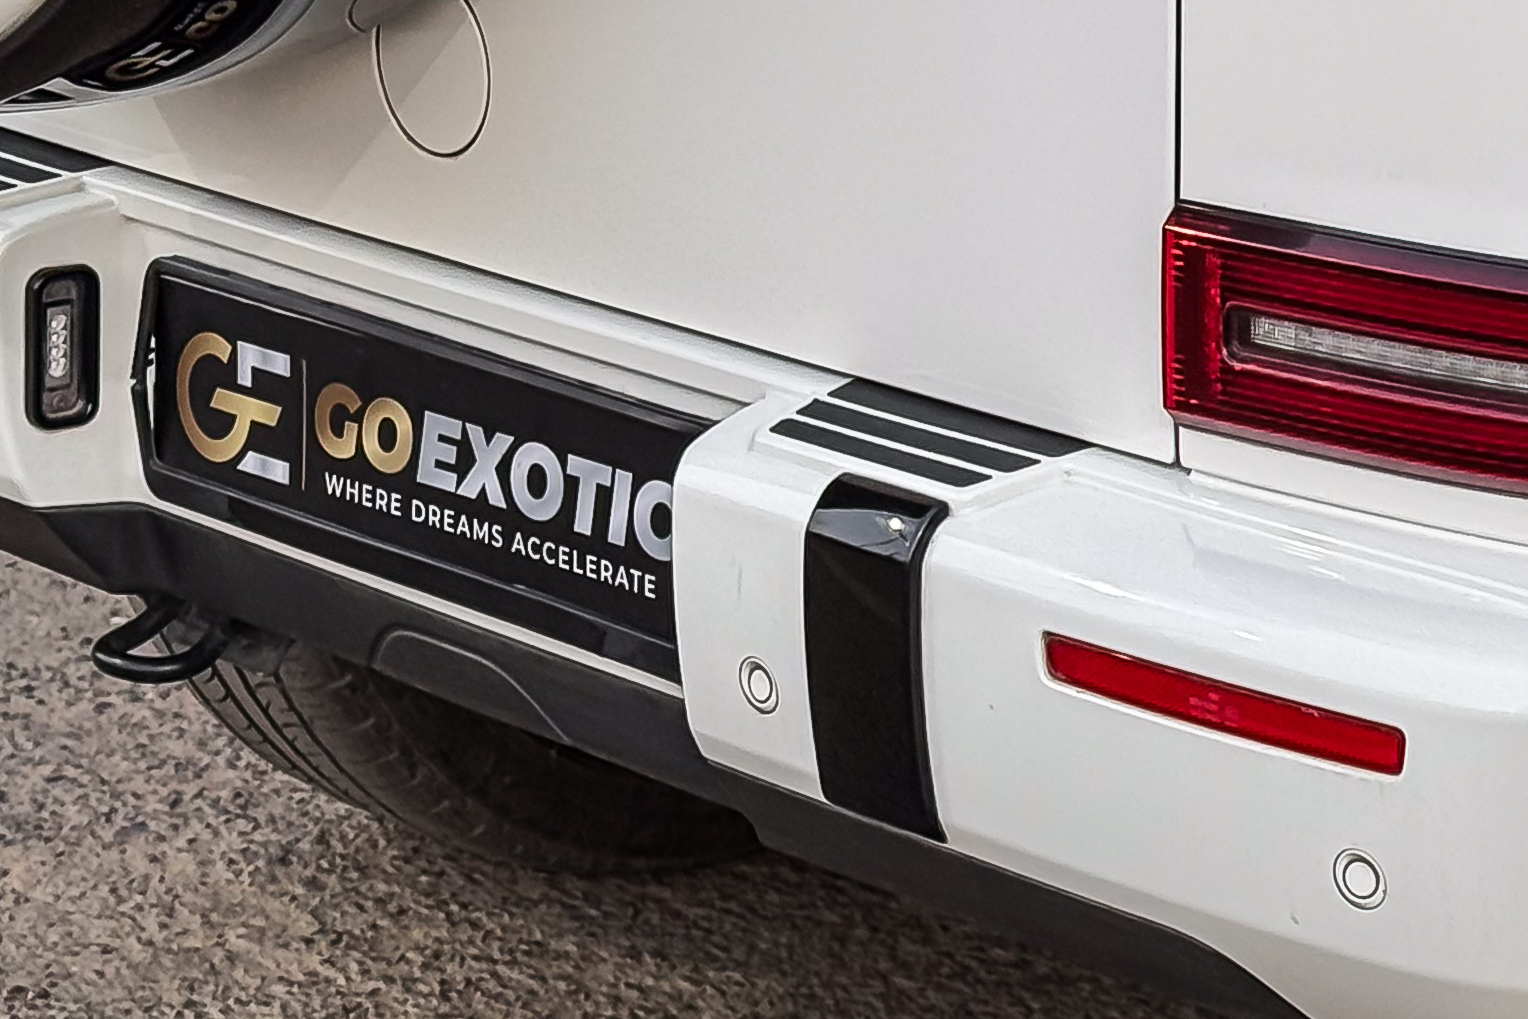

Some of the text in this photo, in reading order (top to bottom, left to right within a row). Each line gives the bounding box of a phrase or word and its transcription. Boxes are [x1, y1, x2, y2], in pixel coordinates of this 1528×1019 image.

[314, 382, 672, 562] GOEXOTIC
[324, 471, 657, 599] WHERE DREAMS ACCELERATE
